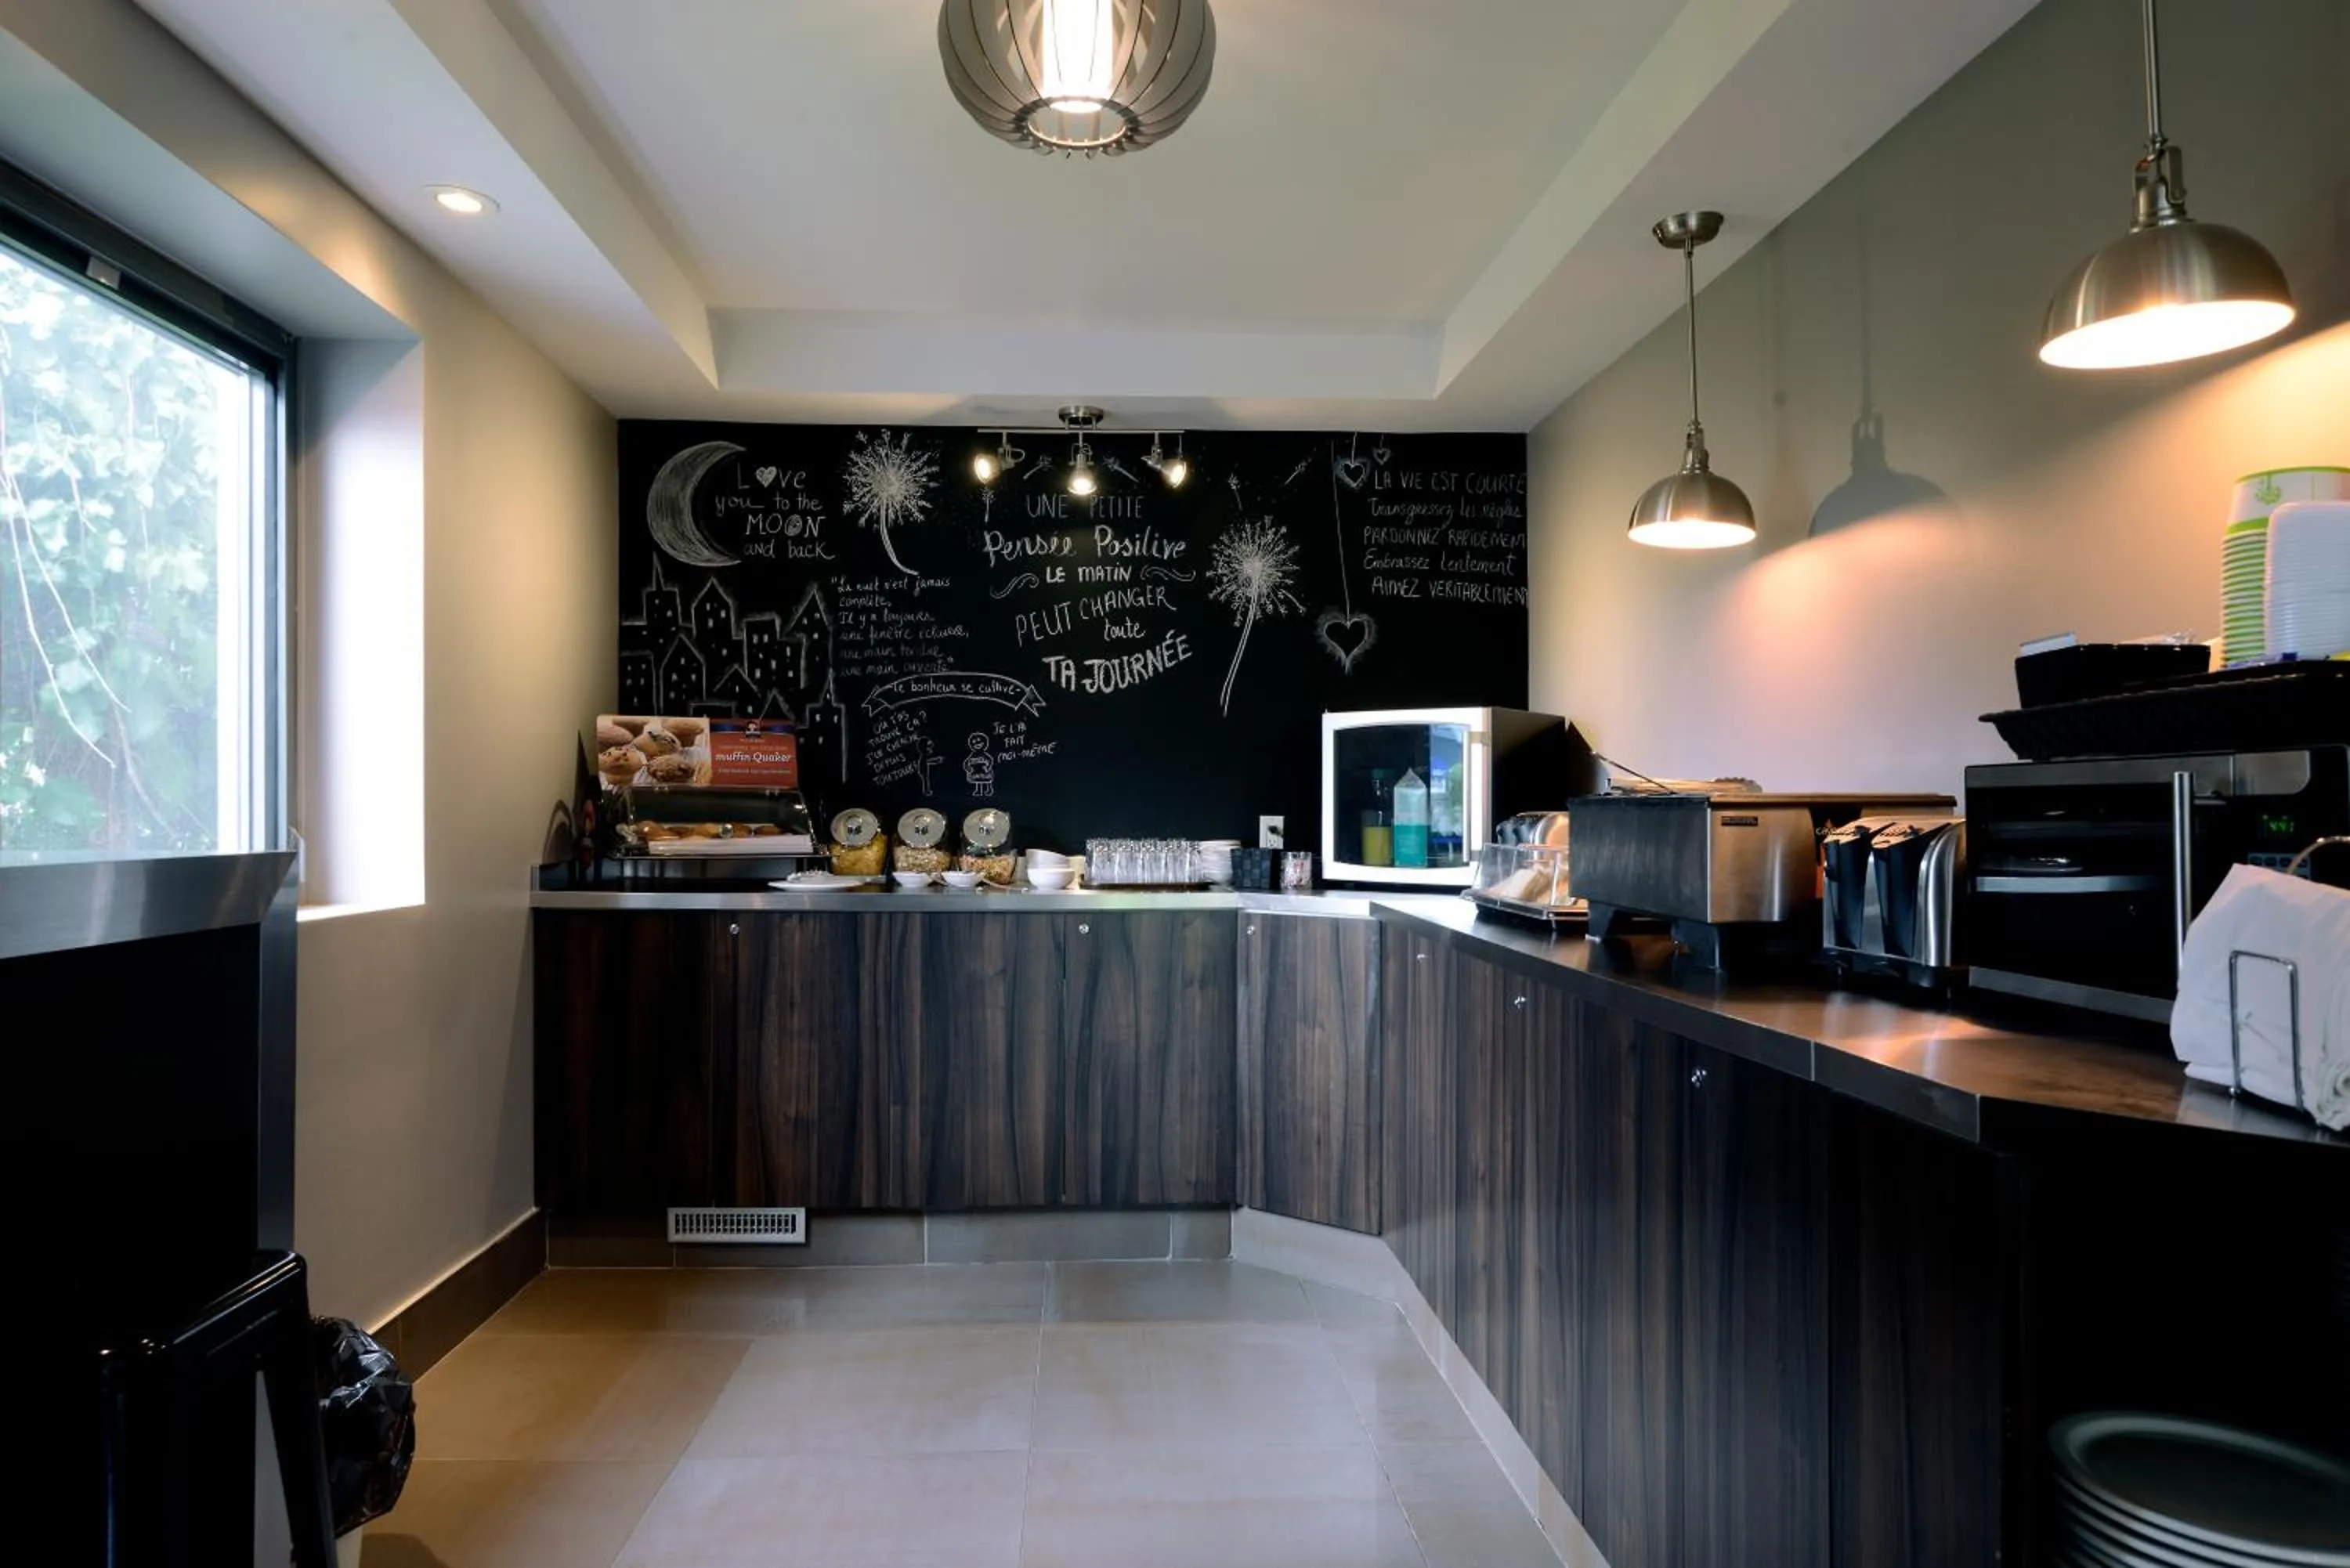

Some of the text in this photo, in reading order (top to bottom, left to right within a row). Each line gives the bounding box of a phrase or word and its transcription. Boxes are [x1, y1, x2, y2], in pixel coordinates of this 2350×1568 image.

[1375, 471, 1392, 490] LA
[1400, 472, 1423, 490] VIE
[1431, 471, 1459, 491] EST
[715, 490, 823, 517] you to the
[1025, 493, 1144, 518] UNE PETITE
[746, 513, 826, 538] MOON
[1364, 526, 1440, 546] PARDONNEZ
[1046, 562, 1132, 583] LE MATIN
[1372, 576, 1421, 597] AIMEZ
[1015, 585, 1177, 647] PEUT CHANGER
[1104, 616, 1146, 641] toute
[1042, 630, 1193, 693] TA JOURNÉE
[911, 677, 958, 693] bonheur
[961, 683, 974, 694] se
[992, 721, 1007, 735] JE
[1003, 735, 1025, 749] FAIT
[715, 751, 790, 764] muffin Quaker
